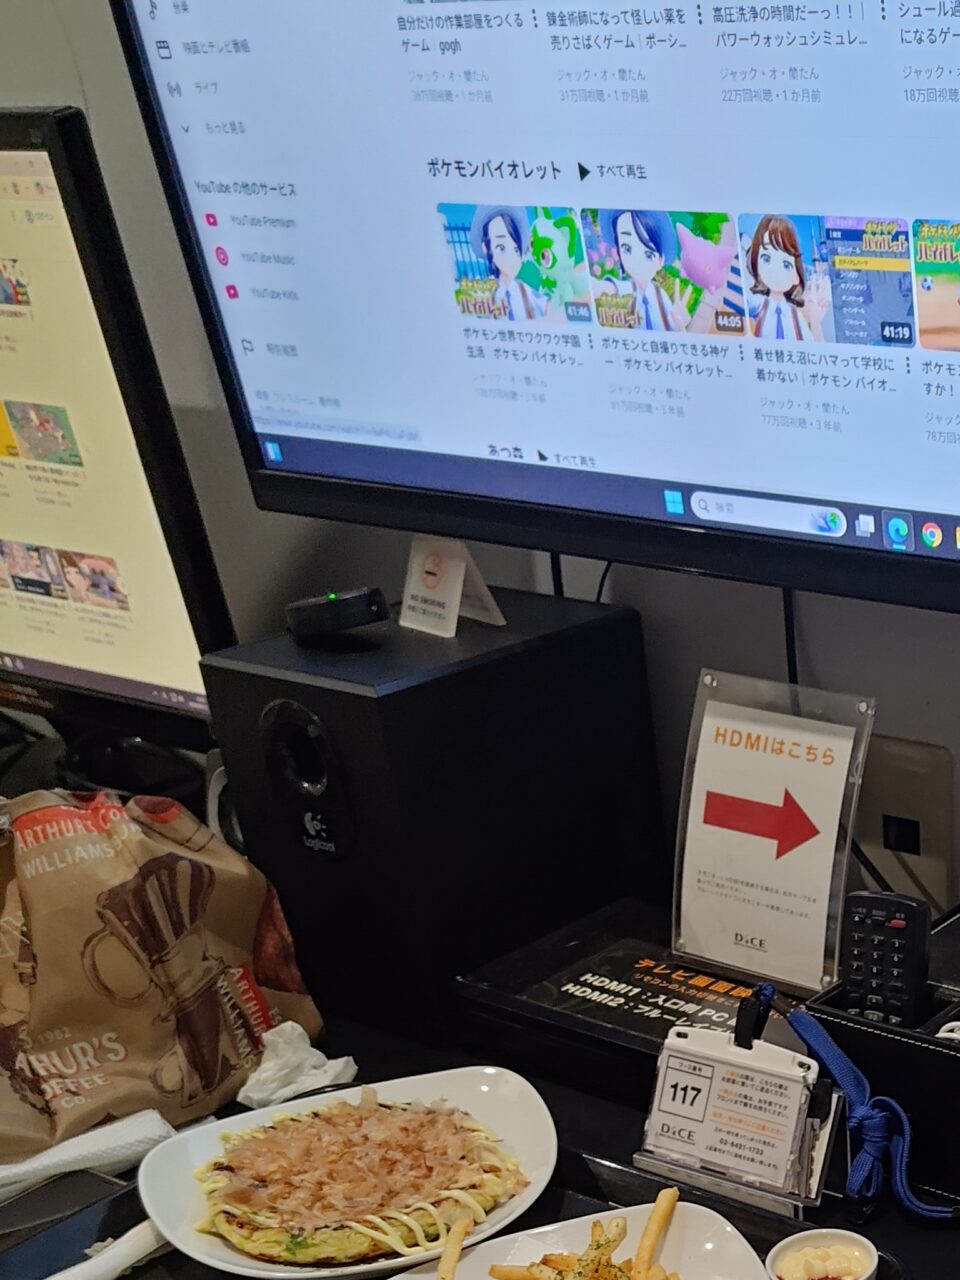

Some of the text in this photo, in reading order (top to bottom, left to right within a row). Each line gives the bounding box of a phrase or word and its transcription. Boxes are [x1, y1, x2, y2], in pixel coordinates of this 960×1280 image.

[396, 13, 524, 30] 自分だけの作業部屋をつくる
[439, 38, 461, 54] gogh
[596, 163, 648, 180] すべて再生
[882, 325, 911, 339] 41:19
[714, 726, 836, 766] HDMIはこちら
[22, 843, 114, 879] WILLIAMS
[230, 967, 267, 1038] ARTHUR
[670, 1082, 702, 1107] 117
